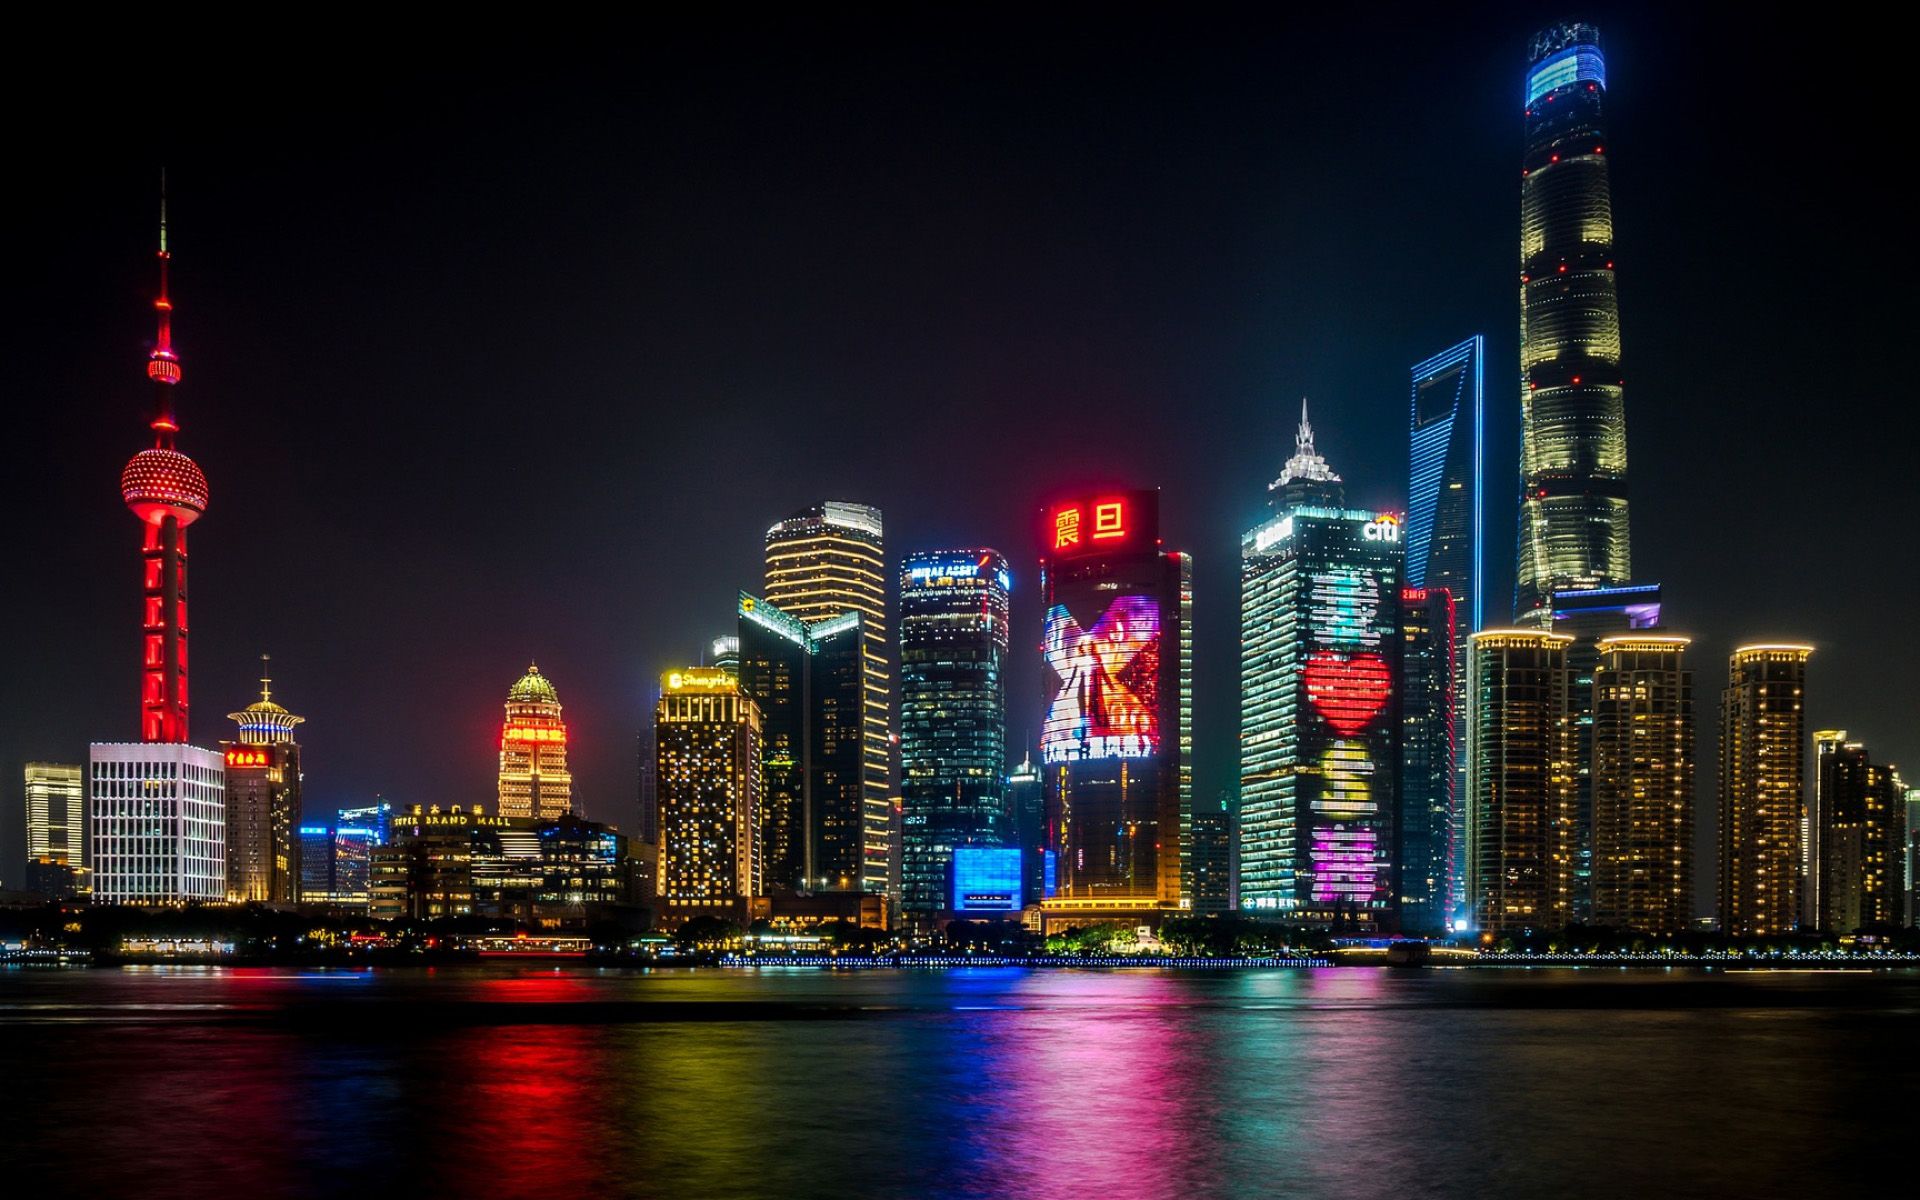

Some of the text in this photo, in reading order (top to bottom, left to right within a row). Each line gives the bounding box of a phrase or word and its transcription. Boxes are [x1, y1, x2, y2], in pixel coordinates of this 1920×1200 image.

[1056, 503, 1125, 549] 震旦
[1363, 515, 1399, 541] citi
[945, 564, 979, 576] ASSET
[394, 816, 510, 826] SUPER BRAND MALL
